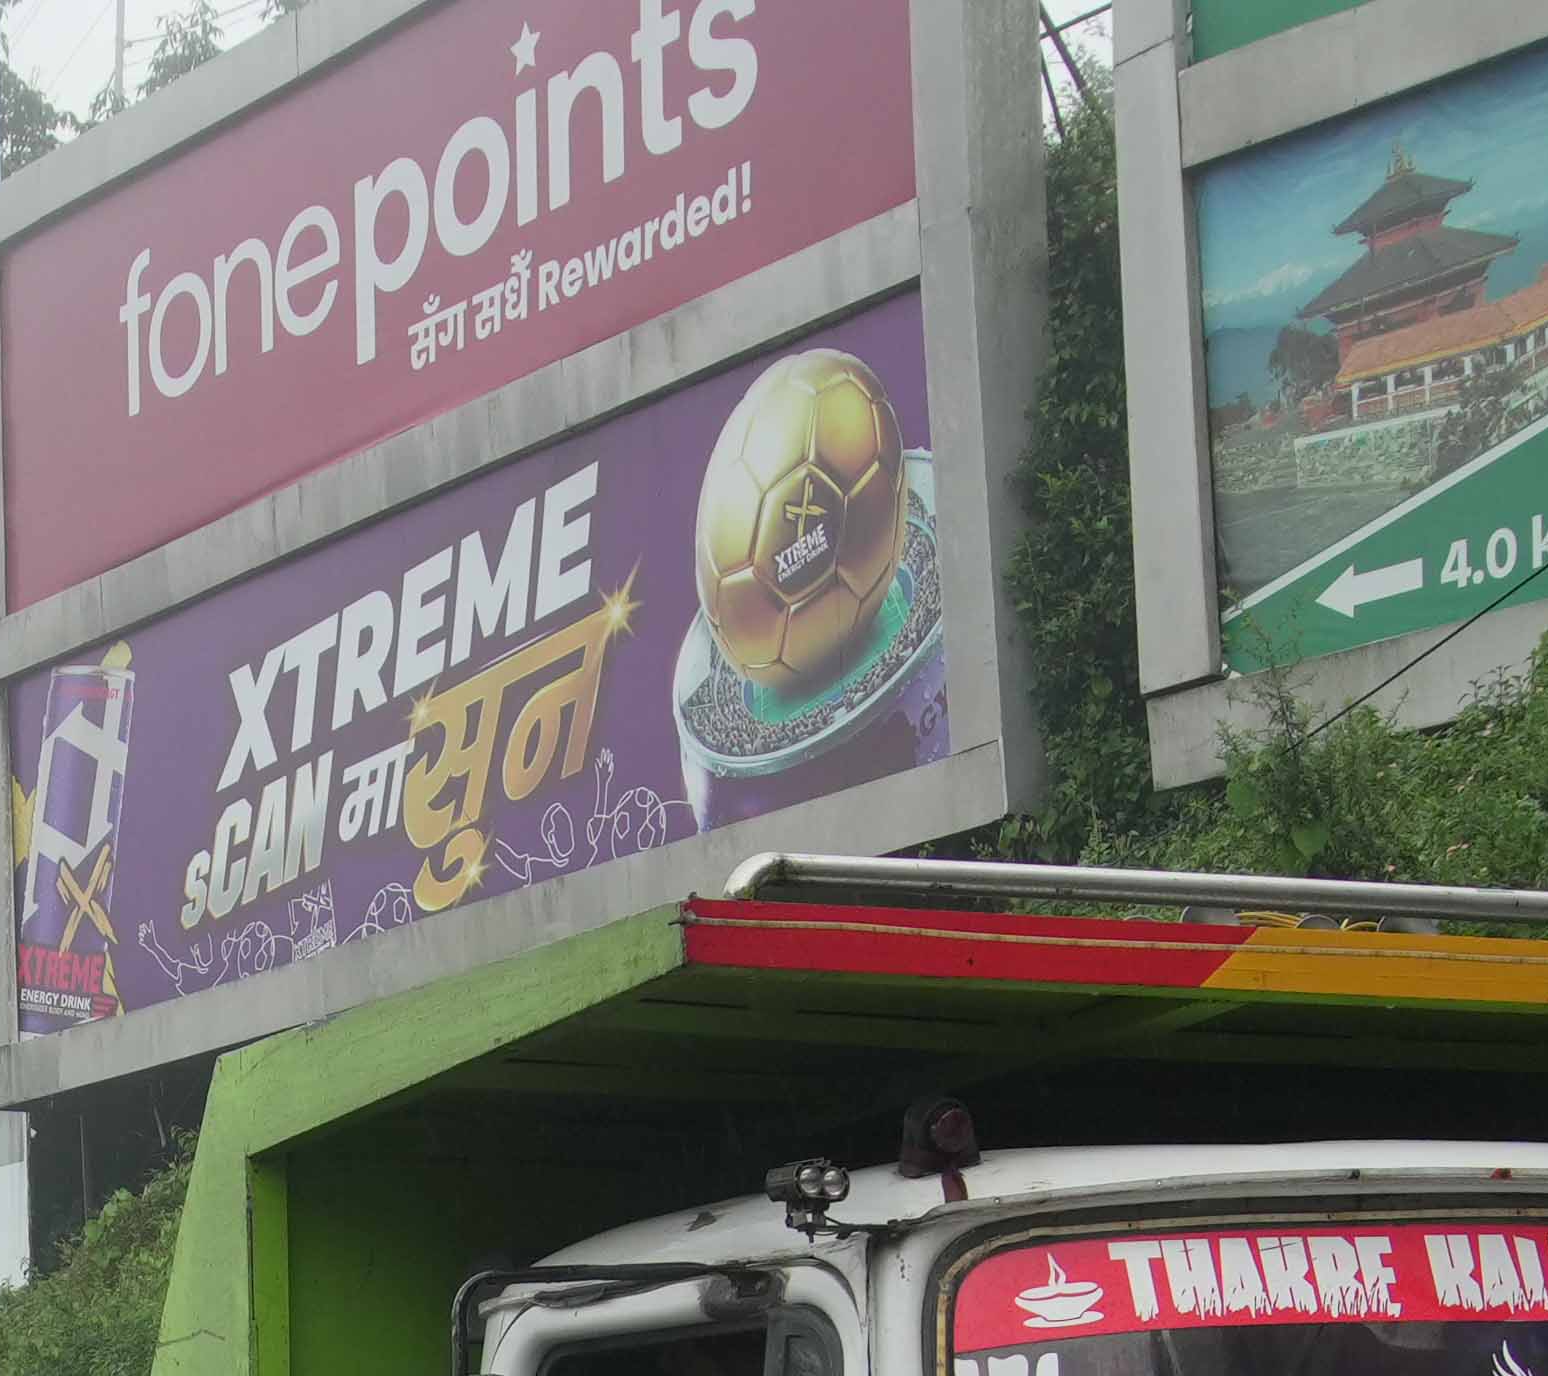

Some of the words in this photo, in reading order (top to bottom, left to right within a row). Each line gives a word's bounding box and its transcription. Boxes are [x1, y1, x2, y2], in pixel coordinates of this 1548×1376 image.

[119, 0, 760, 416] fonepoints
[538, 160, 752, 312] Rewarded!
[1440, 529, 1517, 589] 4.0
[216, 461, 598, 793] XTREME
[17, 943, 105, 995] XTREME
[21, 988, 60, 1006] ENERGY
[61, 994, 92, 1011] DRINK
